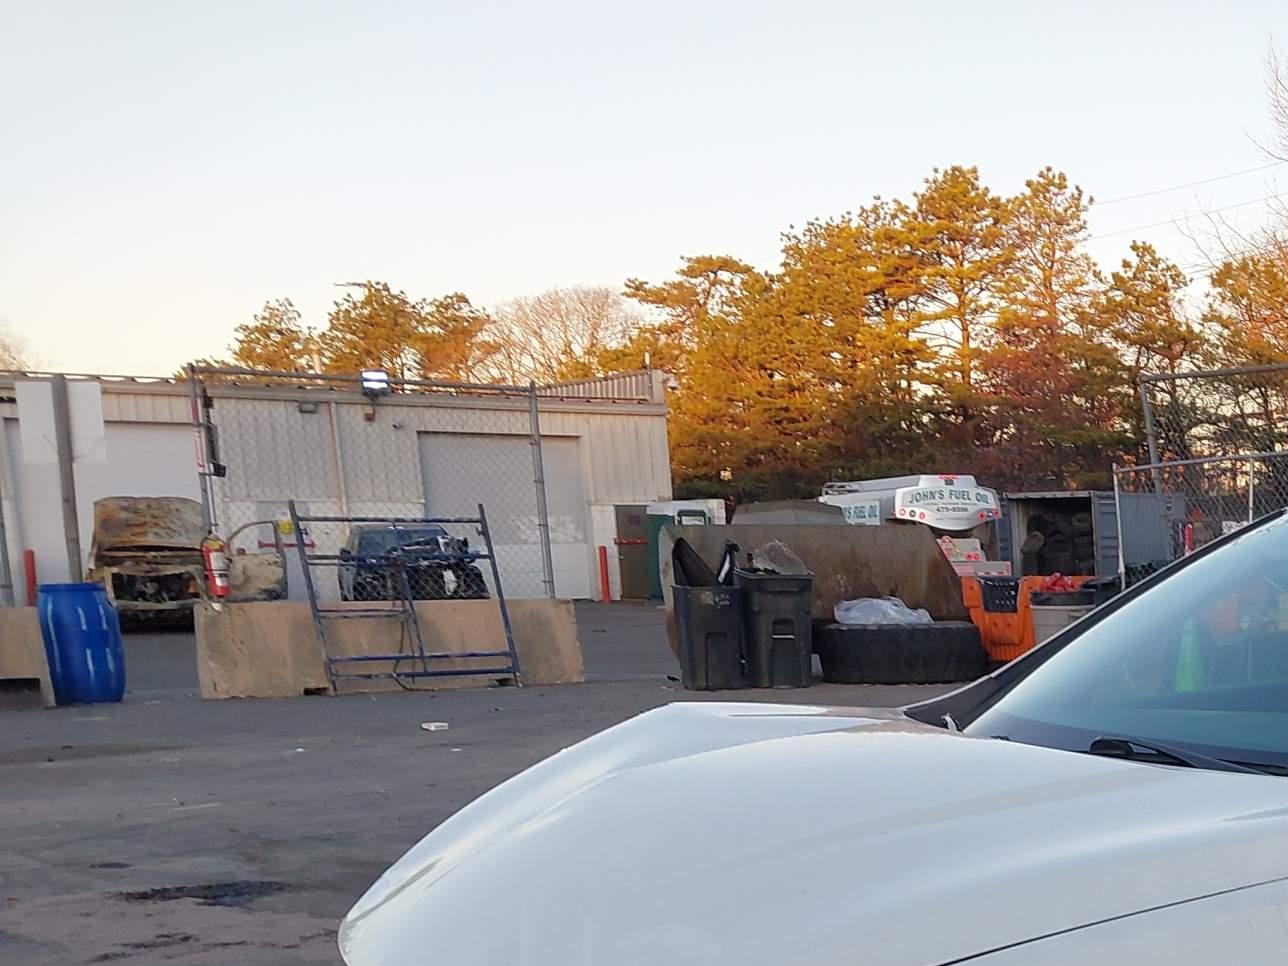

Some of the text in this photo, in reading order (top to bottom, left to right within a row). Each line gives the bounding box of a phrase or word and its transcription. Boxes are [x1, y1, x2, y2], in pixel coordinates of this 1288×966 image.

[908, 489, 990, 504] JOHN'S FUEL OIL
